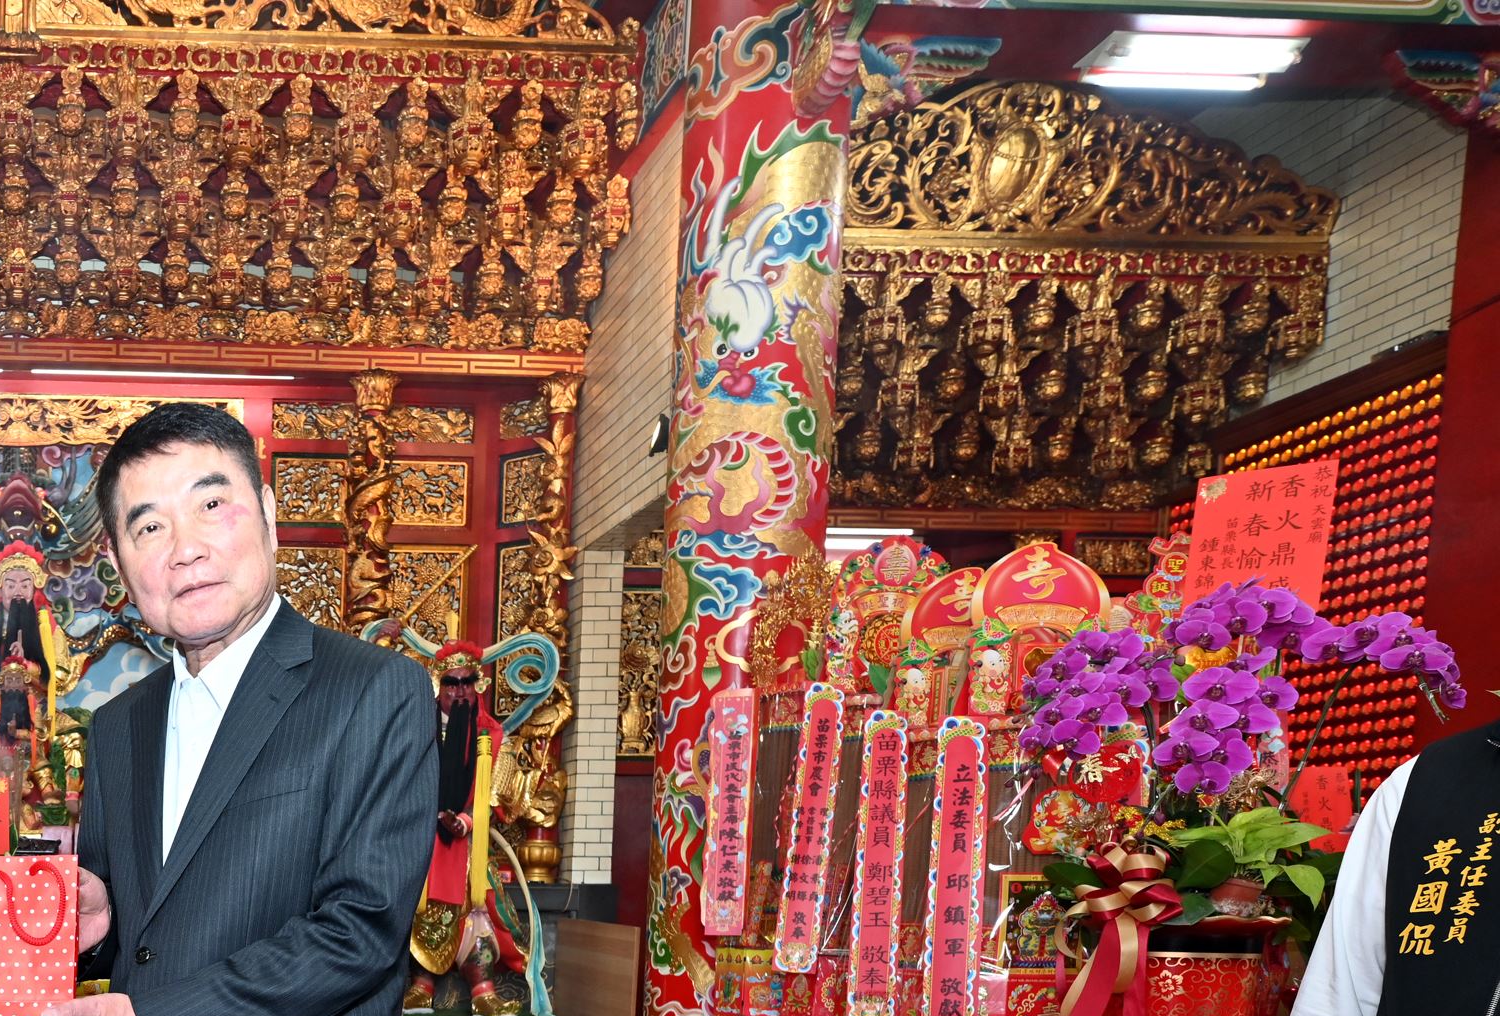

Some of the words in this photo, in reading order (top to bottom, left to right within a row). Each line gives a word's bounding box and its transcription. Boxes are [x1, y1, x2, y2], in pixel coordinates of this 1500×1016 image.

[1310, 465, 1334, 498] 恭祝
[1220, 517, 1239, 569] 苗栗縣長
[1236, 480, 1276, 587] 新春愉
[1305, 504, 1327, 544] 天雲廟
[808, 718, 831, 797] 苗栗市農會
[1398, 838, 1463, 956] 黃國侃
[1443, 812, 1500, 944] 副主任委員
